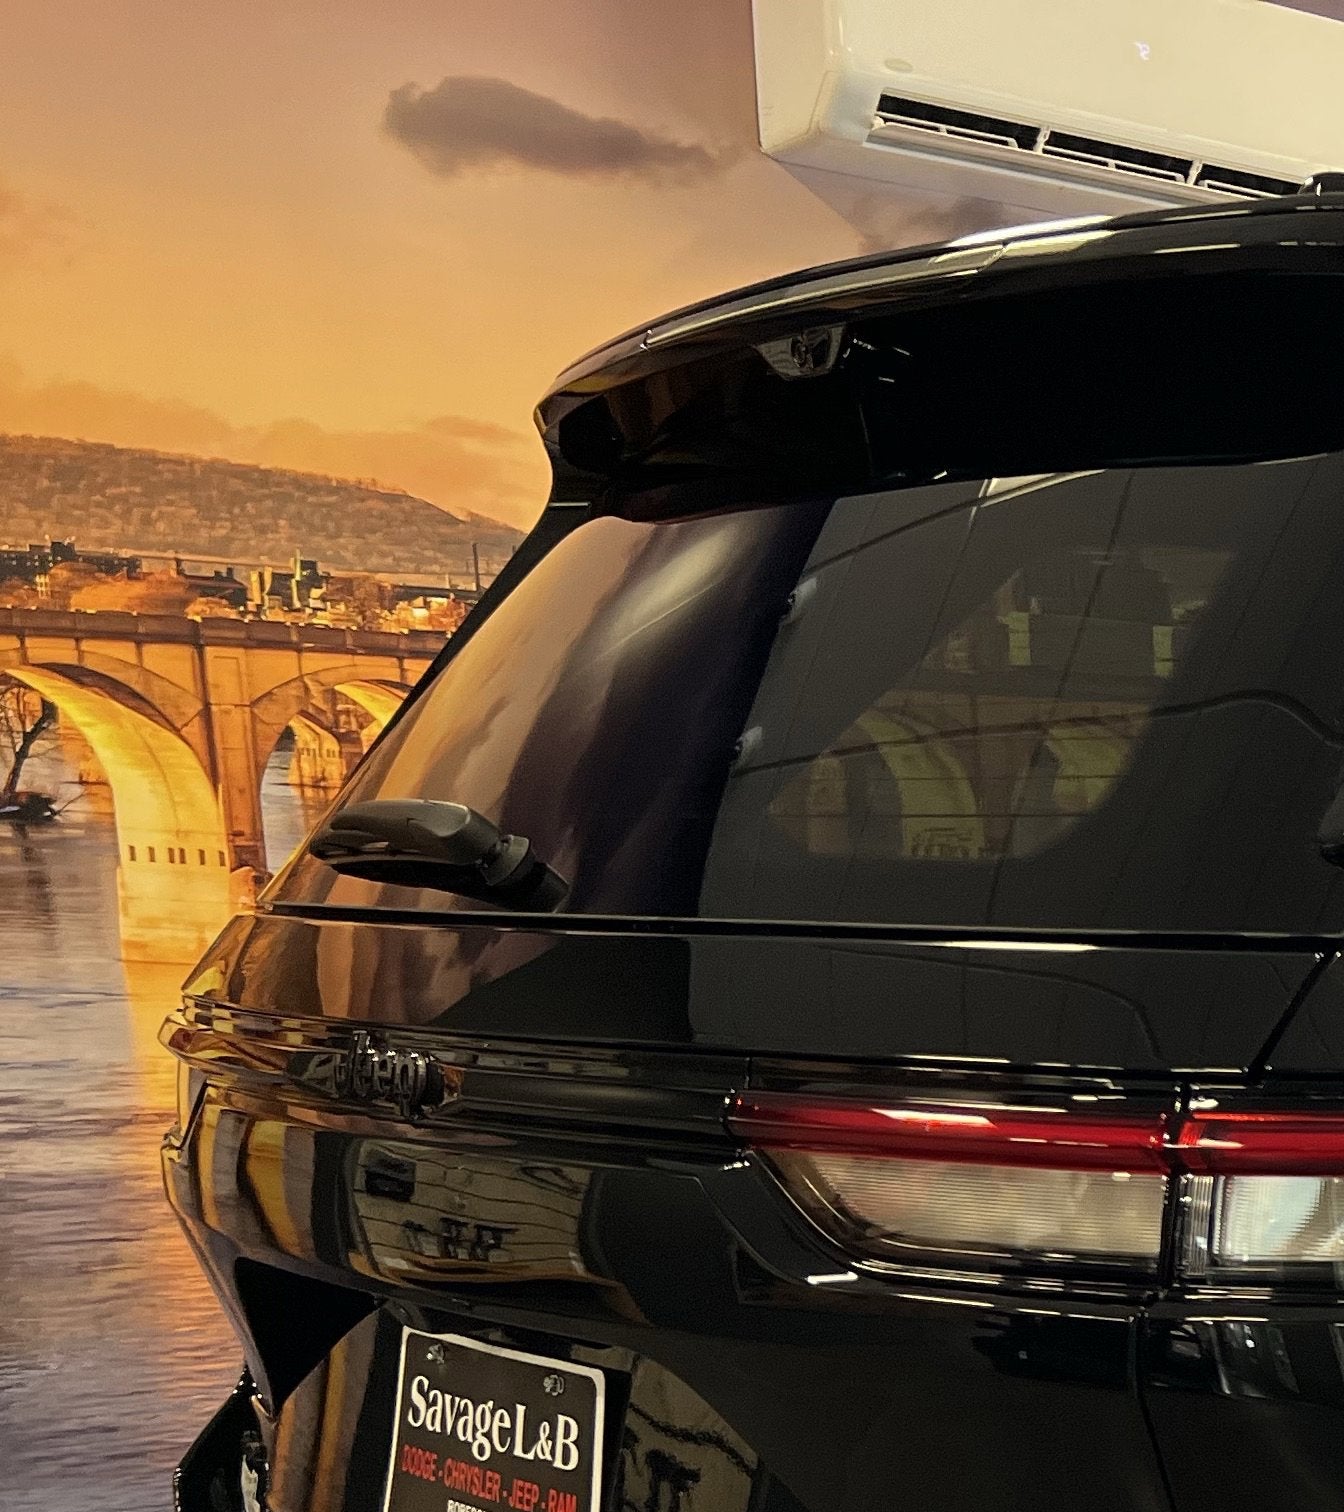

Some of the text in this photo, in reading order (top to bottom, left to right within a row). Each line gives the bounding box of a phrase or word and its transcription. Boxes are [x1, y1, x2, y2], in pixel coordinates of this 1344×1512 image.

[408, 1375, 579, 1471] Savage L&B
[402, 1445, 438, 1482] DODGE
[444, 1458, 501, 1500] CHRYSLER
[509, 1479, 540, 1512] JEEP
